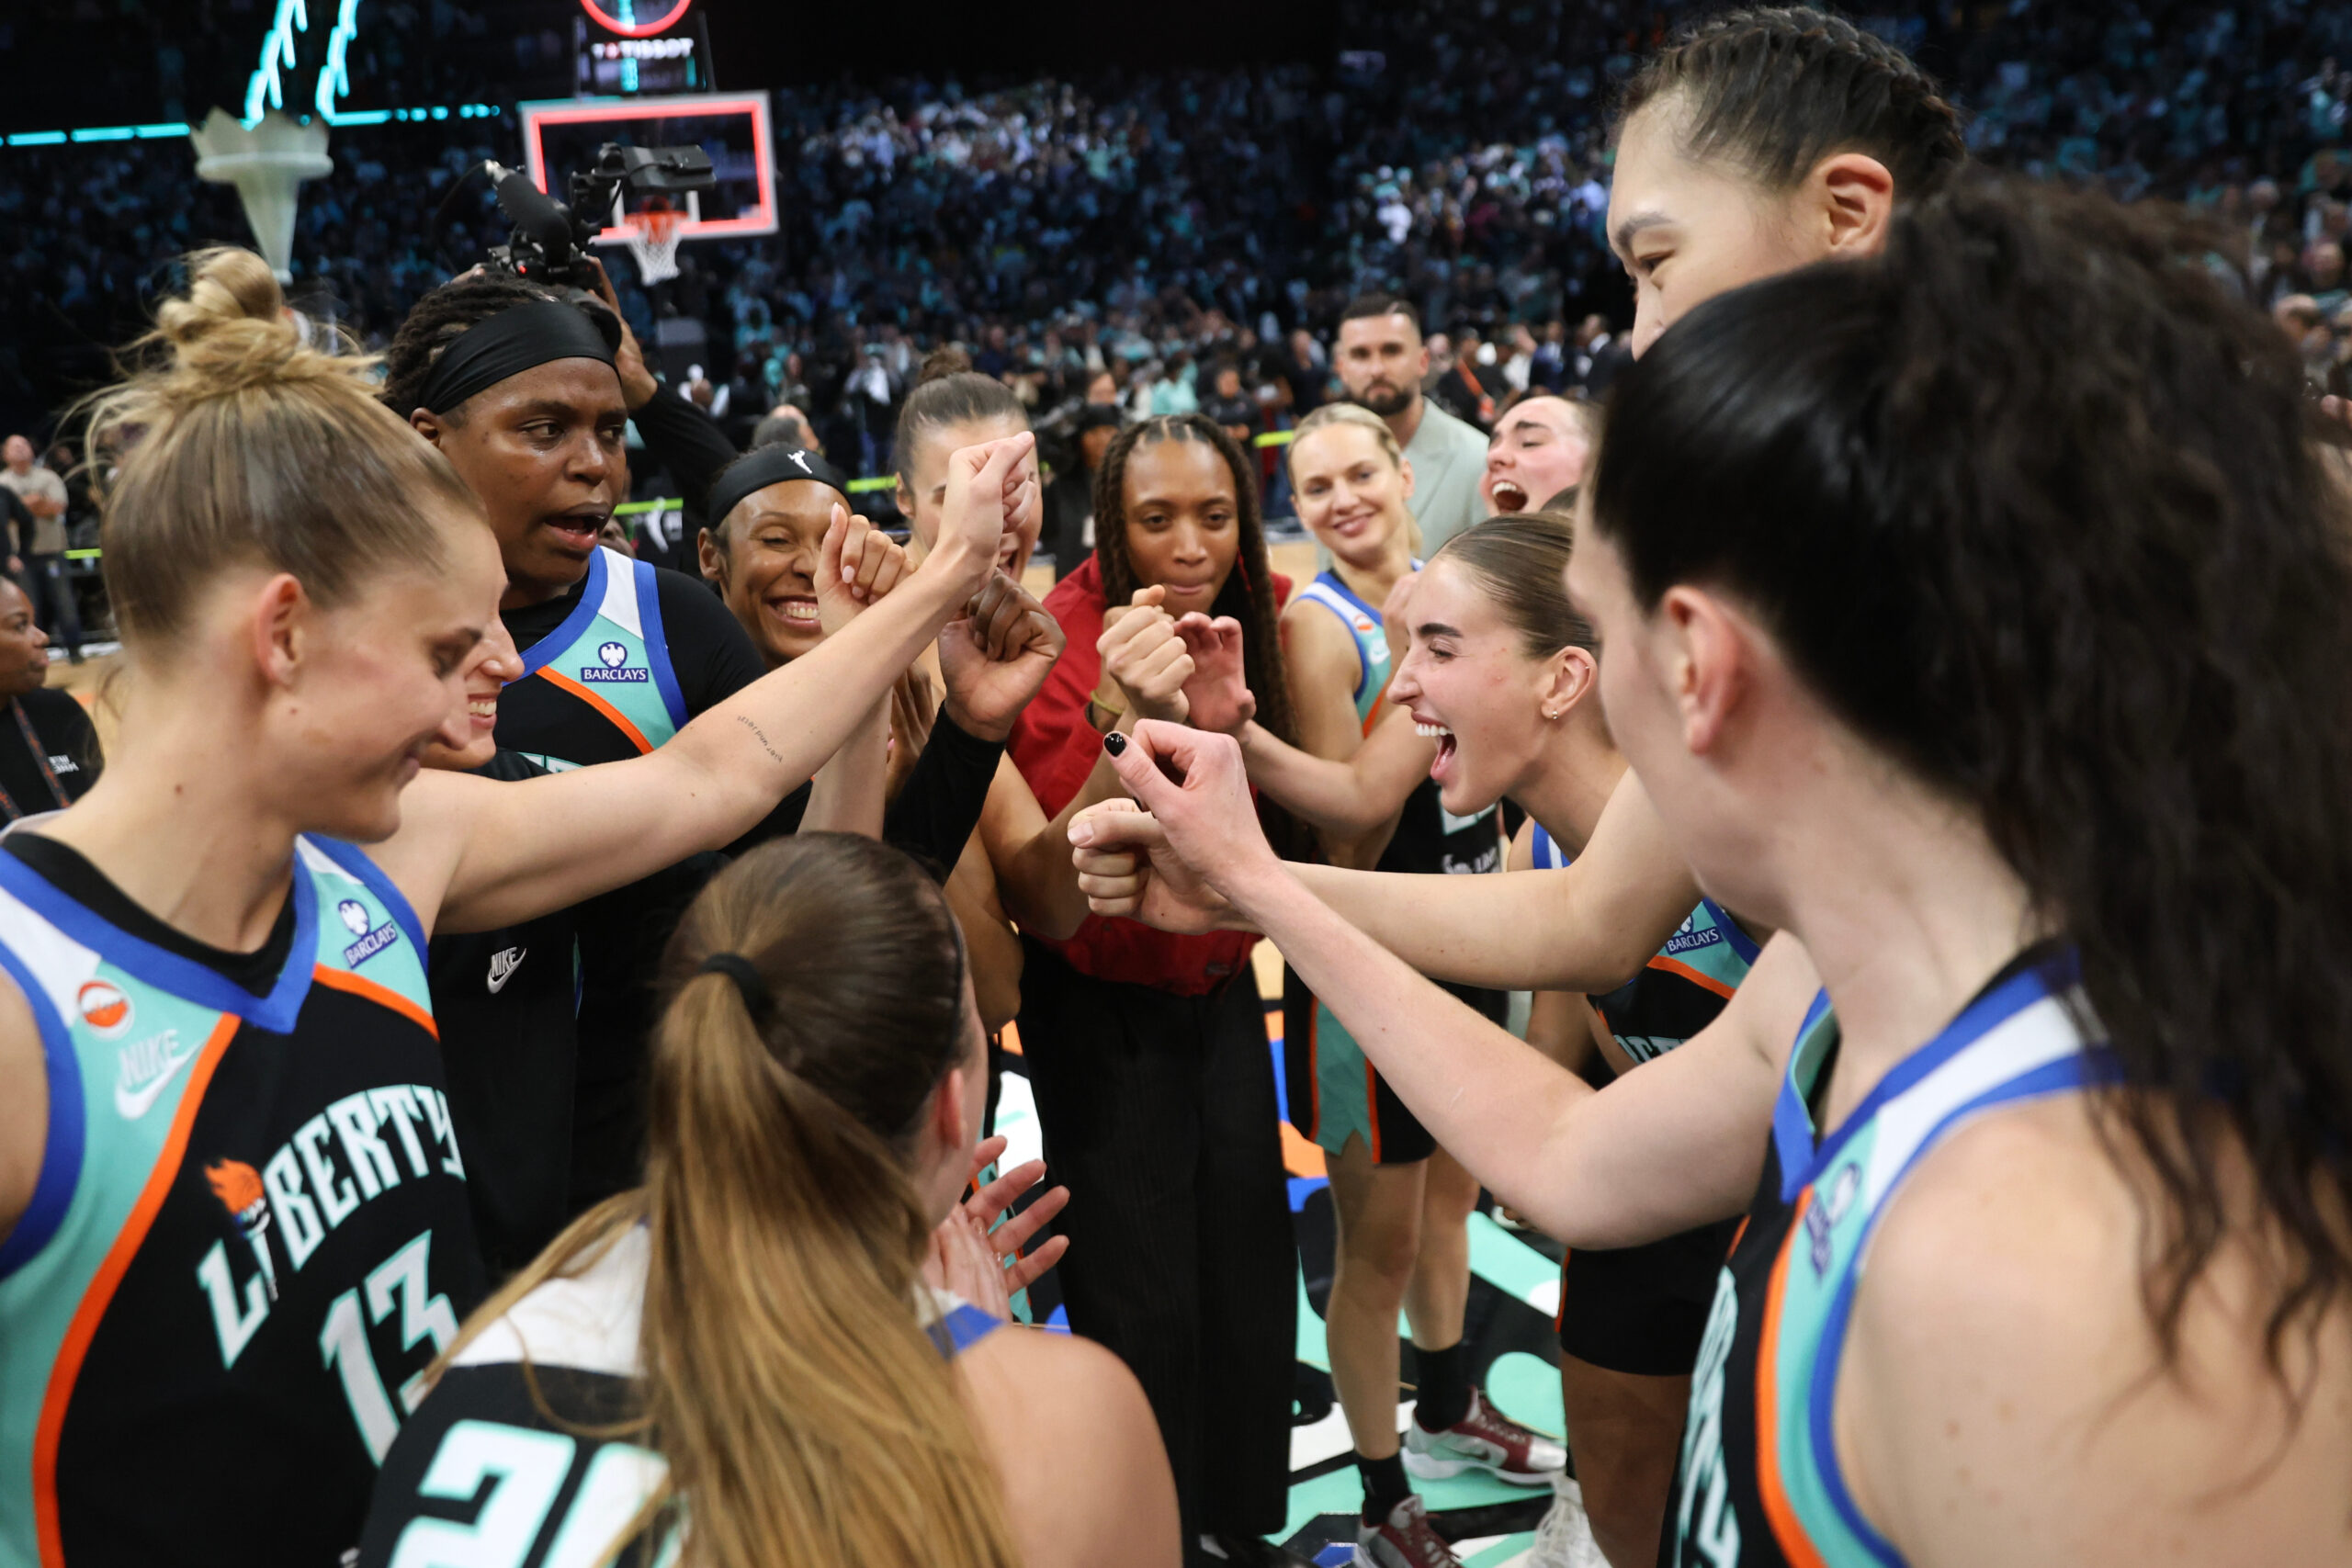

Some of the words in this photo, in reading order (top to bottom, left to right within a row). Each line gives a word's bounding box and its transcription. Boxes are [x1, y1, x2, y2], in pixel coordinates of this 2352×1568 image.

[583, 669, 647, 681] BARCLAYS
[345, 921, 397, 966] BARCLAYS
[1667, 928, 1720, 953] BARCLAYS
[491, 946, 518, 978] NIKE
[118, 1028, 180, 1088] NIKE
[318, 1228, 460, 1470] 13
